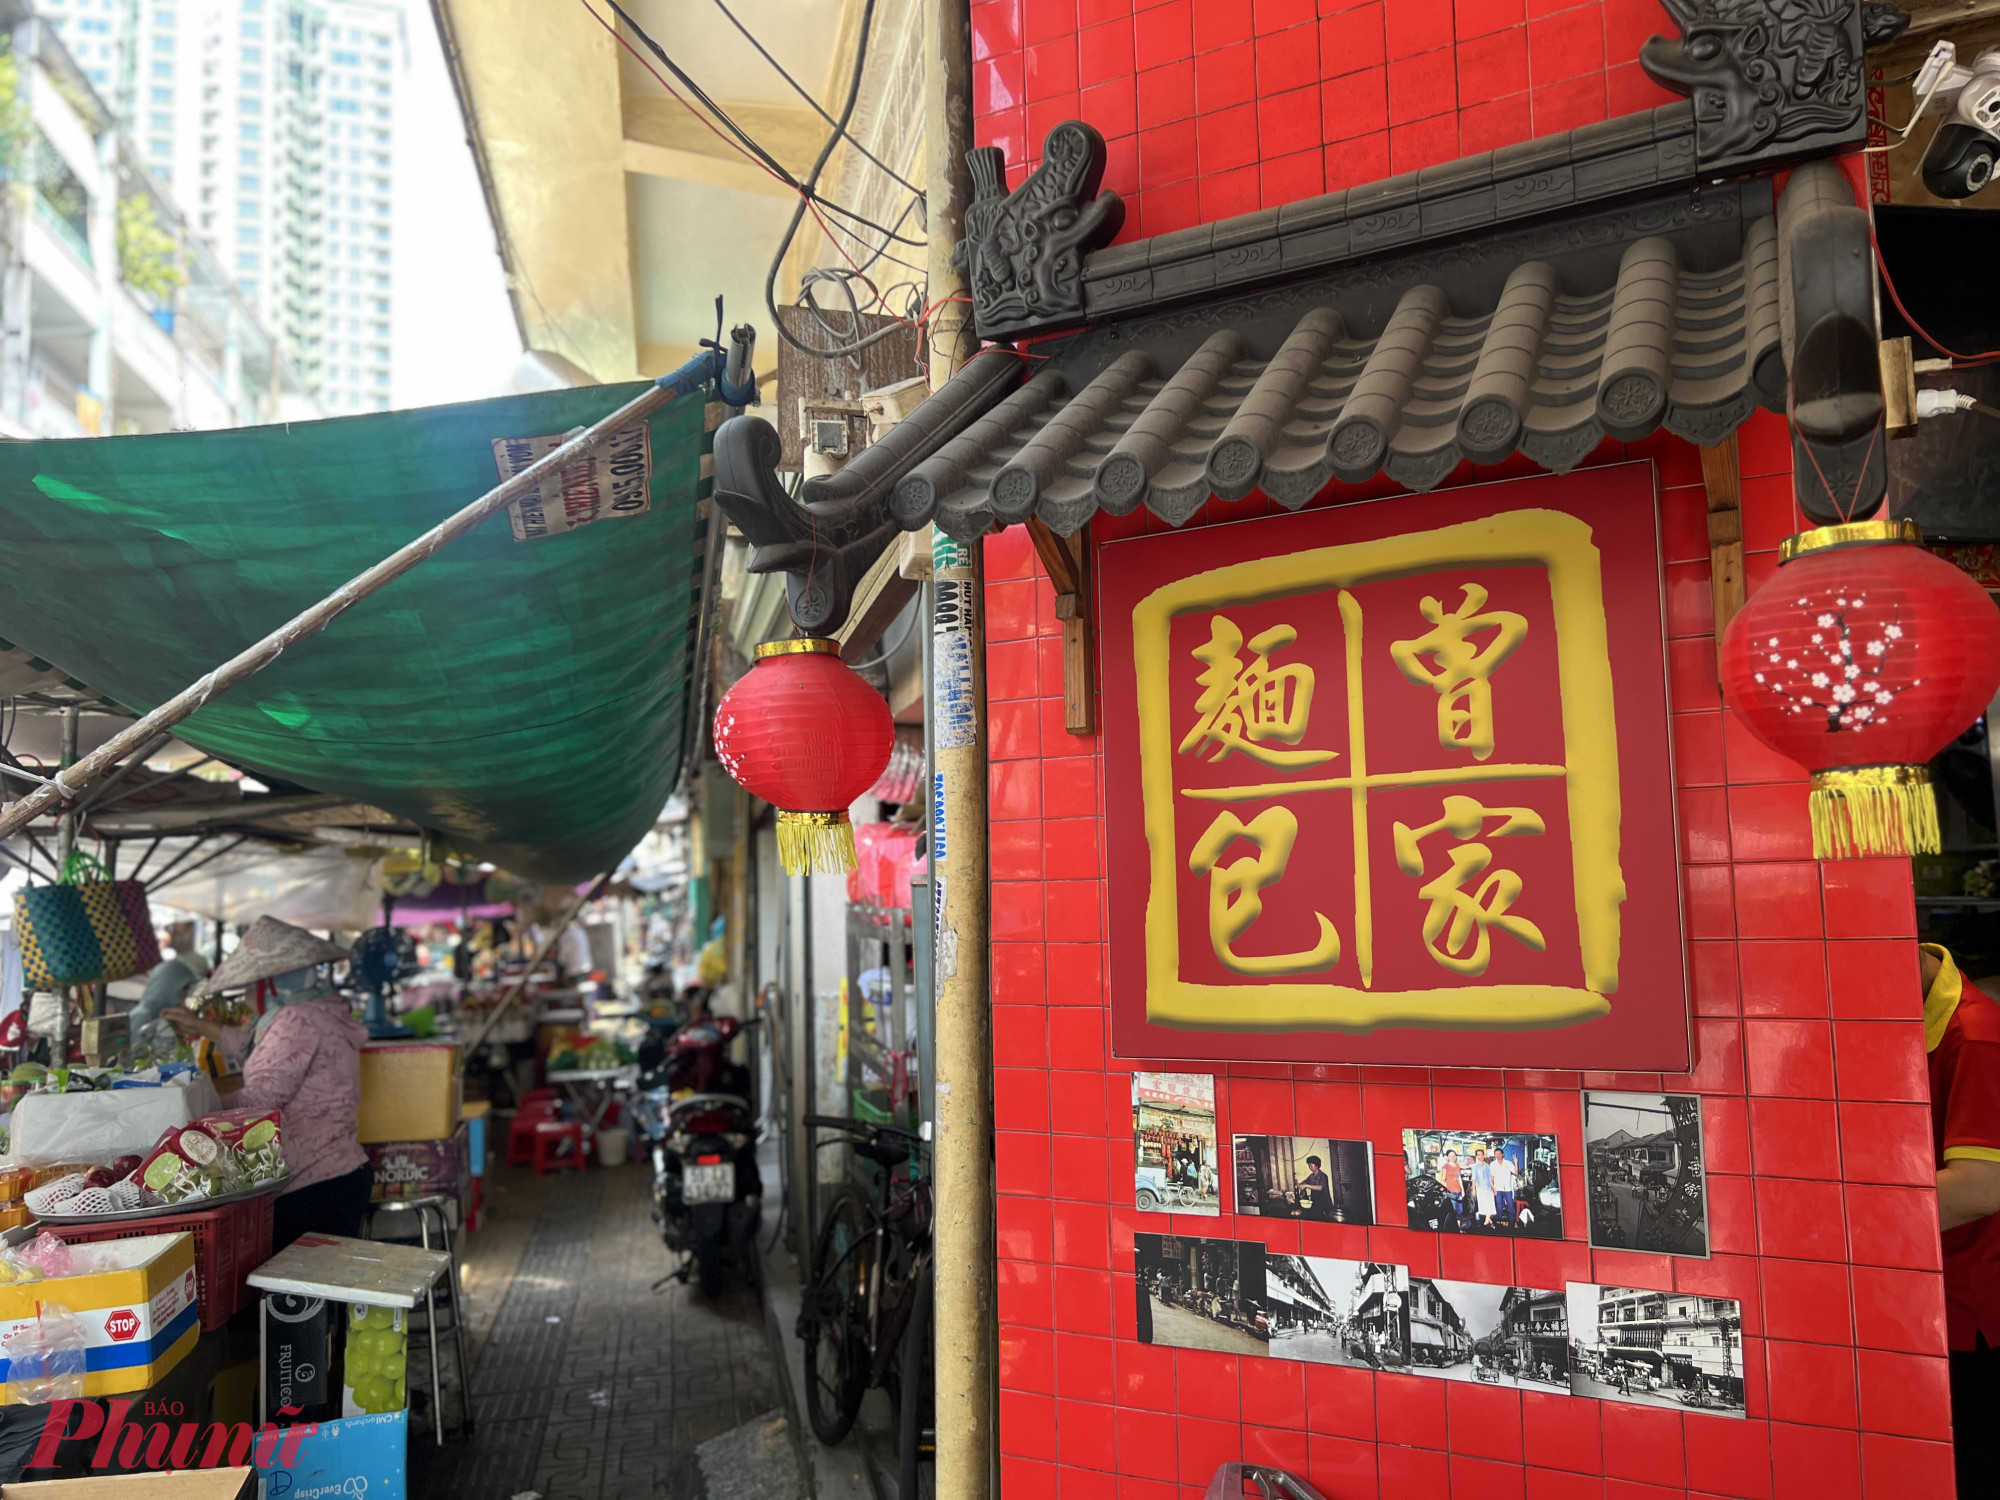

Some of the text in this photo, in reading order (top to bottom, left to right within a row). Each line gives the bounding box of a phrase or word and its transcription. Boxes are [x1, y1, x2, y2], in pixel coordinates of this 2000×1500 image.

[374, 1167, 429, 1183] NORDIC
[109, 1317, 136, 1333] STOP
[345, 1414, 393, 1428] CMI orchards
[294, 1484, 342, 1500] EverCrisp
